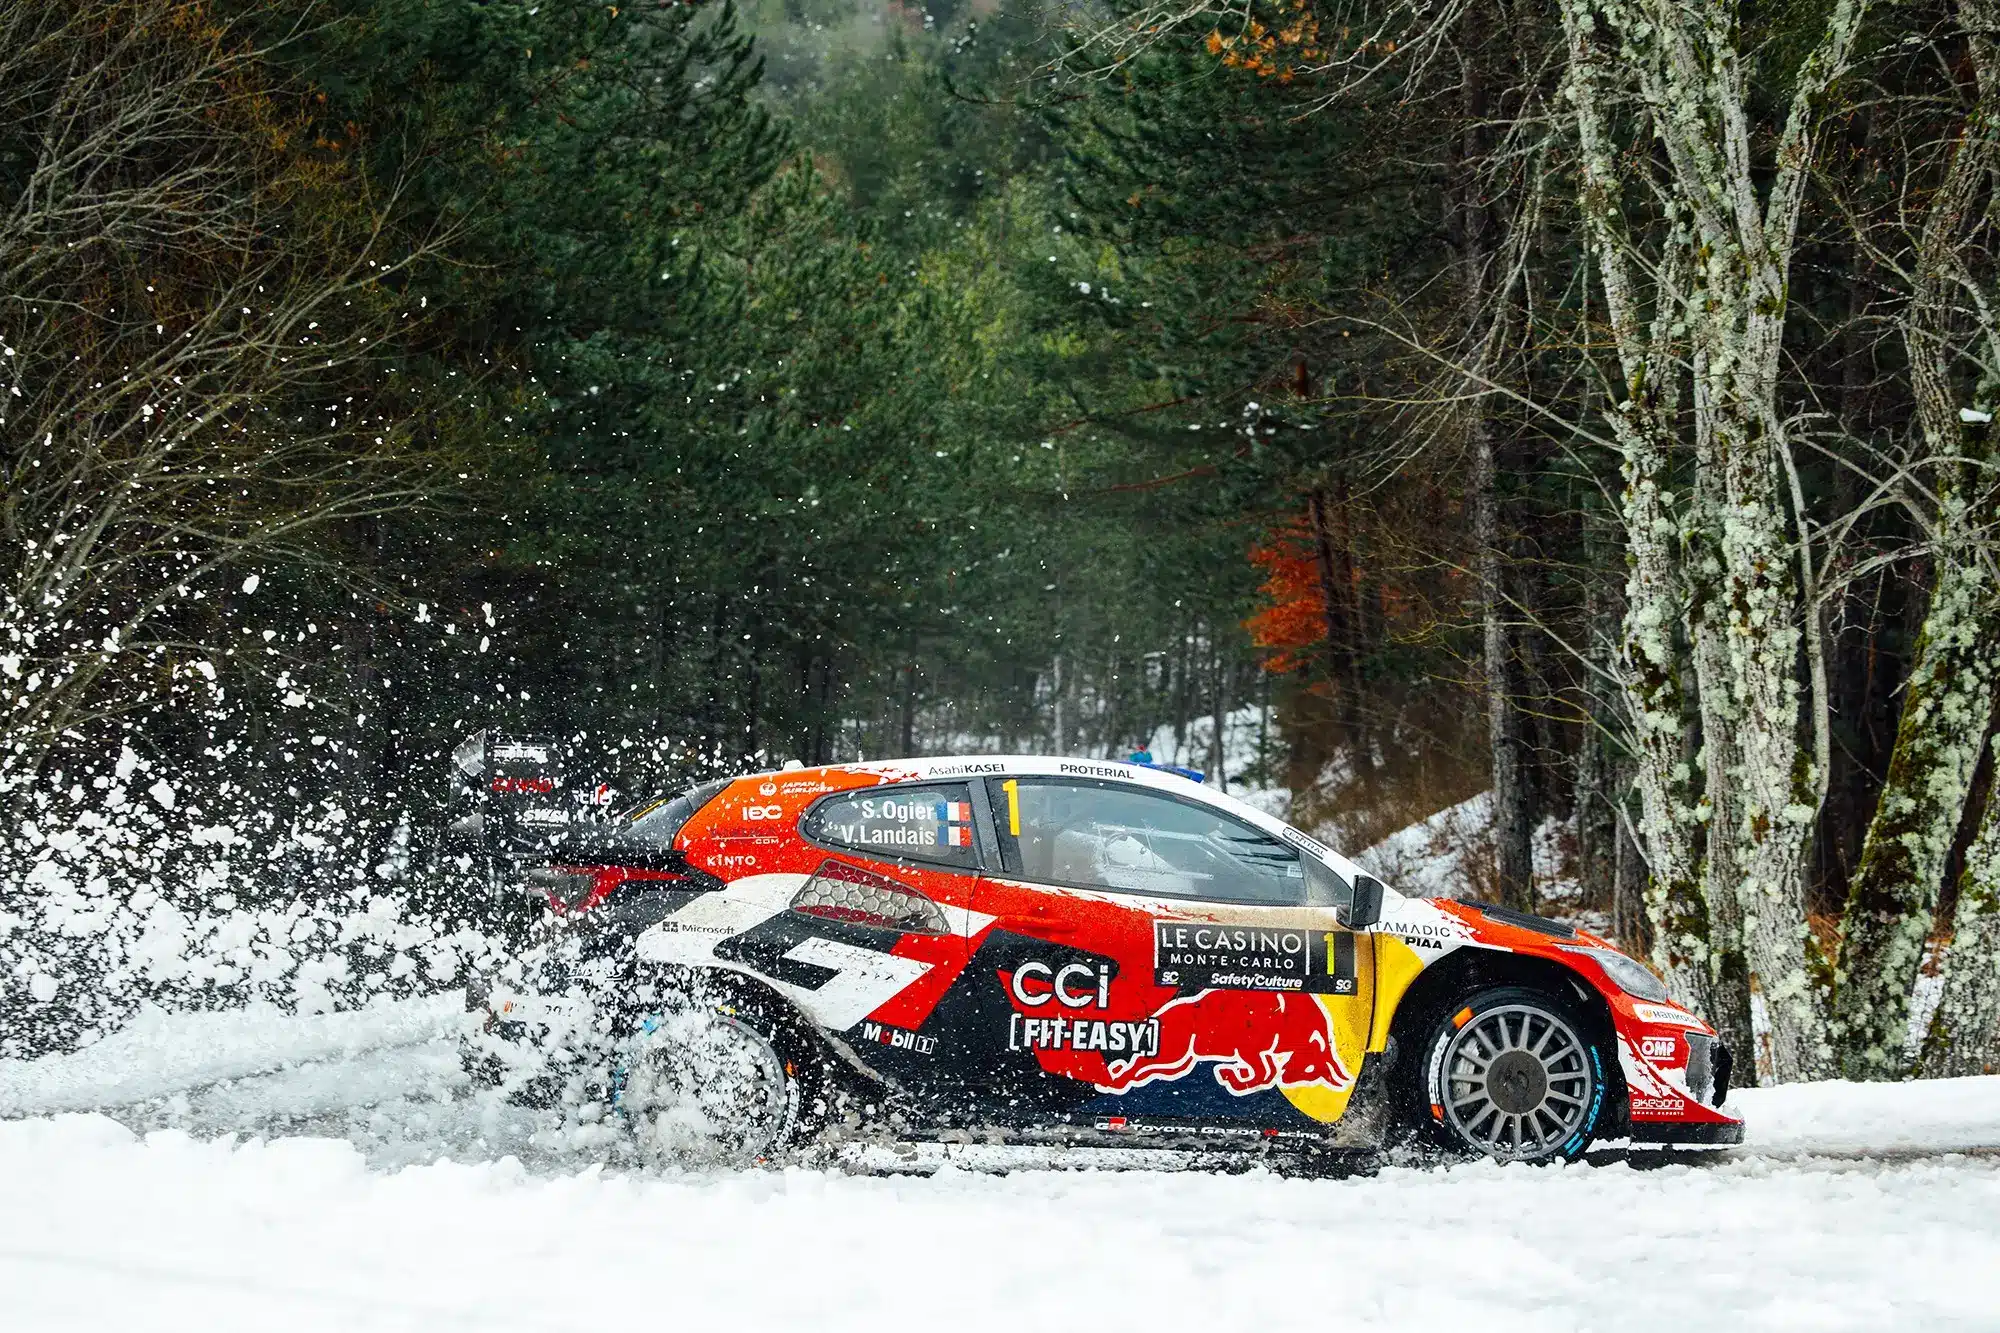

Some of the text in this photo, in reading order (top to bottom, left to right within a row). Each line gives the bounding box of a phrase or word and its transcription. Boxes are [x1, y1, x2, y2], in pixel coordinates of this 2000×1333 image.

[1060, 763, 1134, 779] PROTERIAL
[1002, 779, 1020, 836] 1
[682, 924, 735, 935] Microsoft
[1161, 928, 1302, 954] LE CASINO
[1405, 936, 1442, 950] PIAA
[1323, 932, 1336, 976] 1
[1210, 972, 1303, 989] SafetyCulture
[863, 1022, 915, 1050] Mobil
[1641, 1040, 1676, 1057] OMP
[1130, 1124, 1197, 1133] TOYOTA
[1201, 1126, 1261, 1136] GAZOO
[1263, 1127, 1320, 1140] Racing
